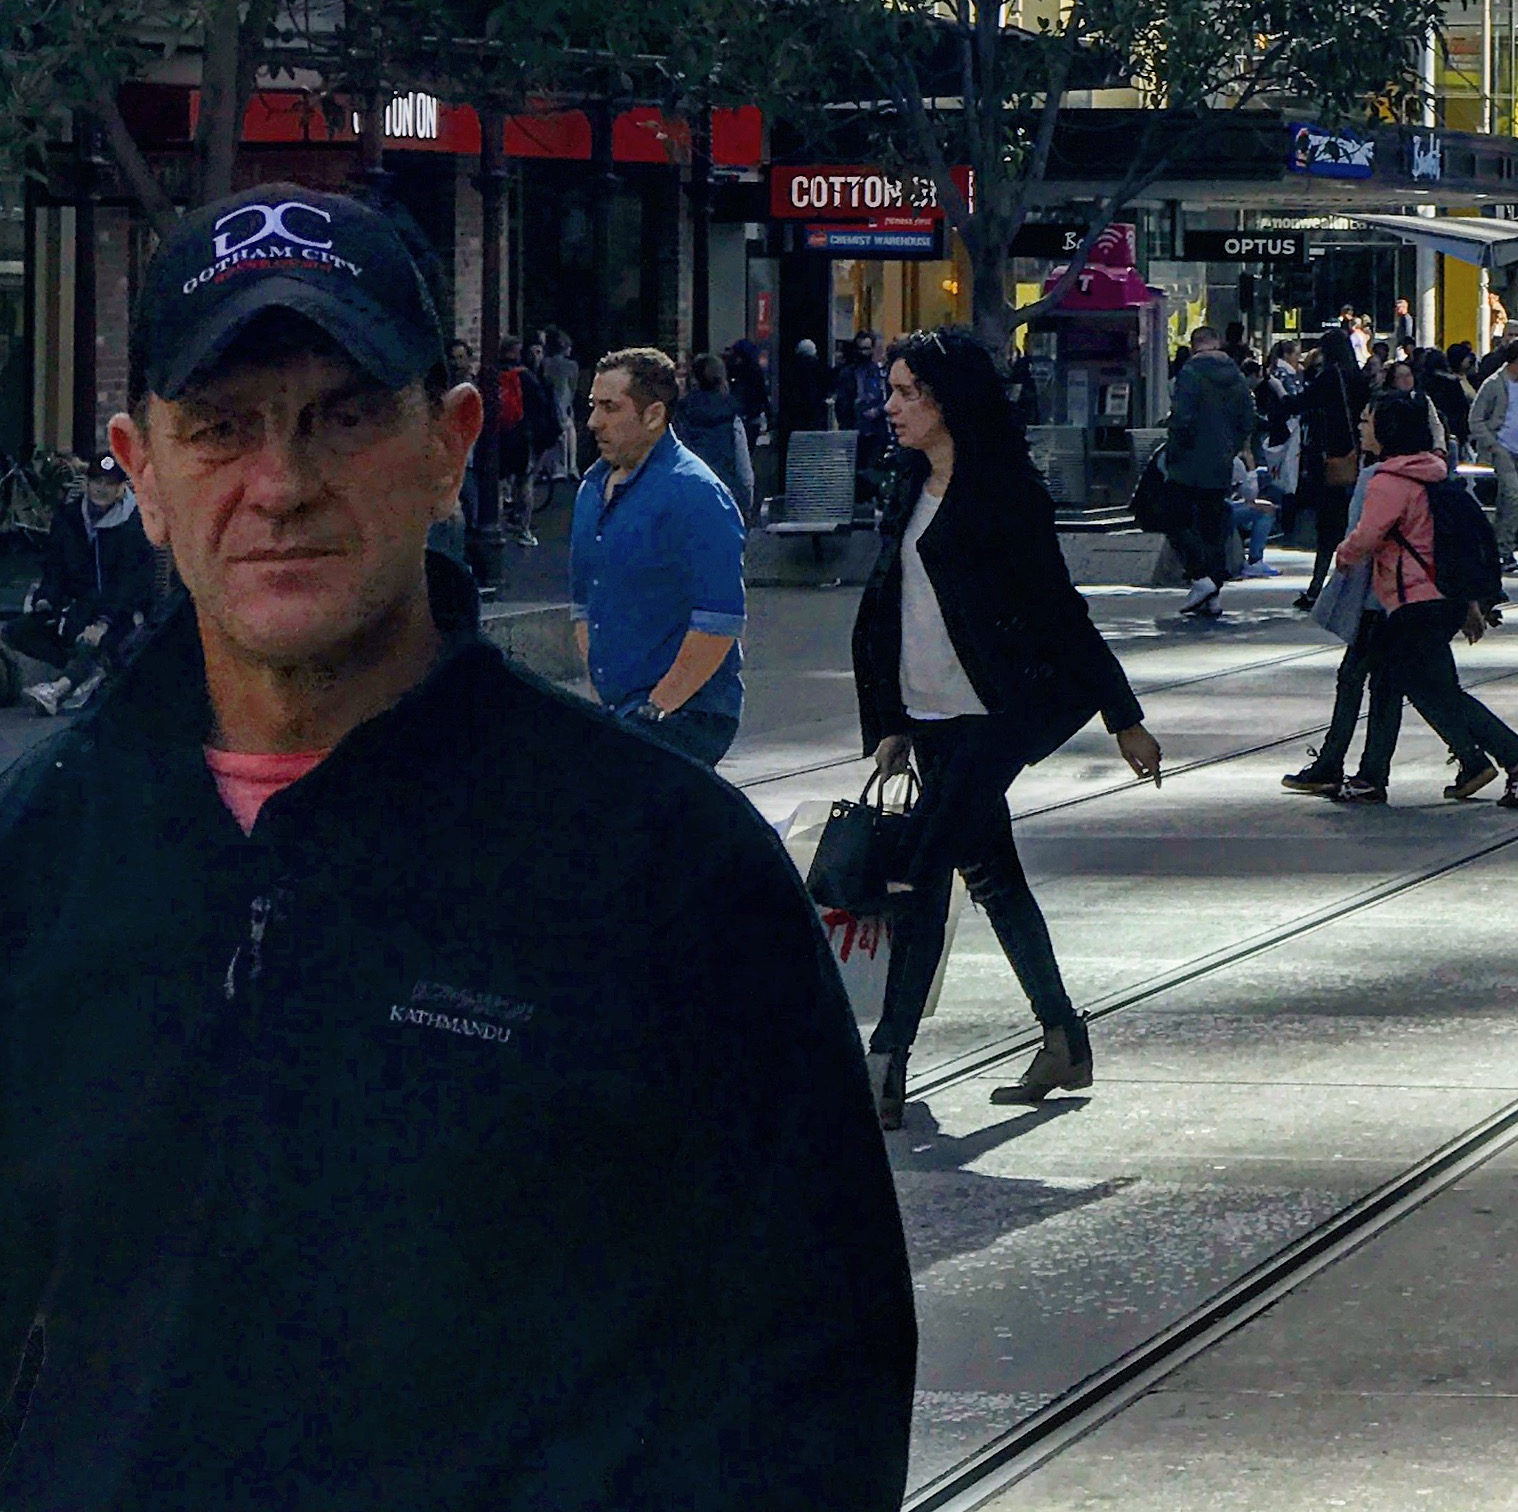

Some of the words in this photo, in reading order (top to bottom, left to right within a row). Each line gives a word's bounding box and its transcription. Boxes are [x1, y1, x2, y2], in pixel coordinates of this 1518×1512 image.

[416, 92, 437, 139] ON
[791, 175, 903, 208] COTTON
[830, 234, 872, 246] CHEMIST
[873, 235, 932, 247] WAREHOUSE
[1224, 238, 1296, 256] OPTUS
[182, 246, 294, 295] GOTHAM
[302, 248, 363, 278] CITY
[389, 1004, 511, 1043] KATHMANDU
